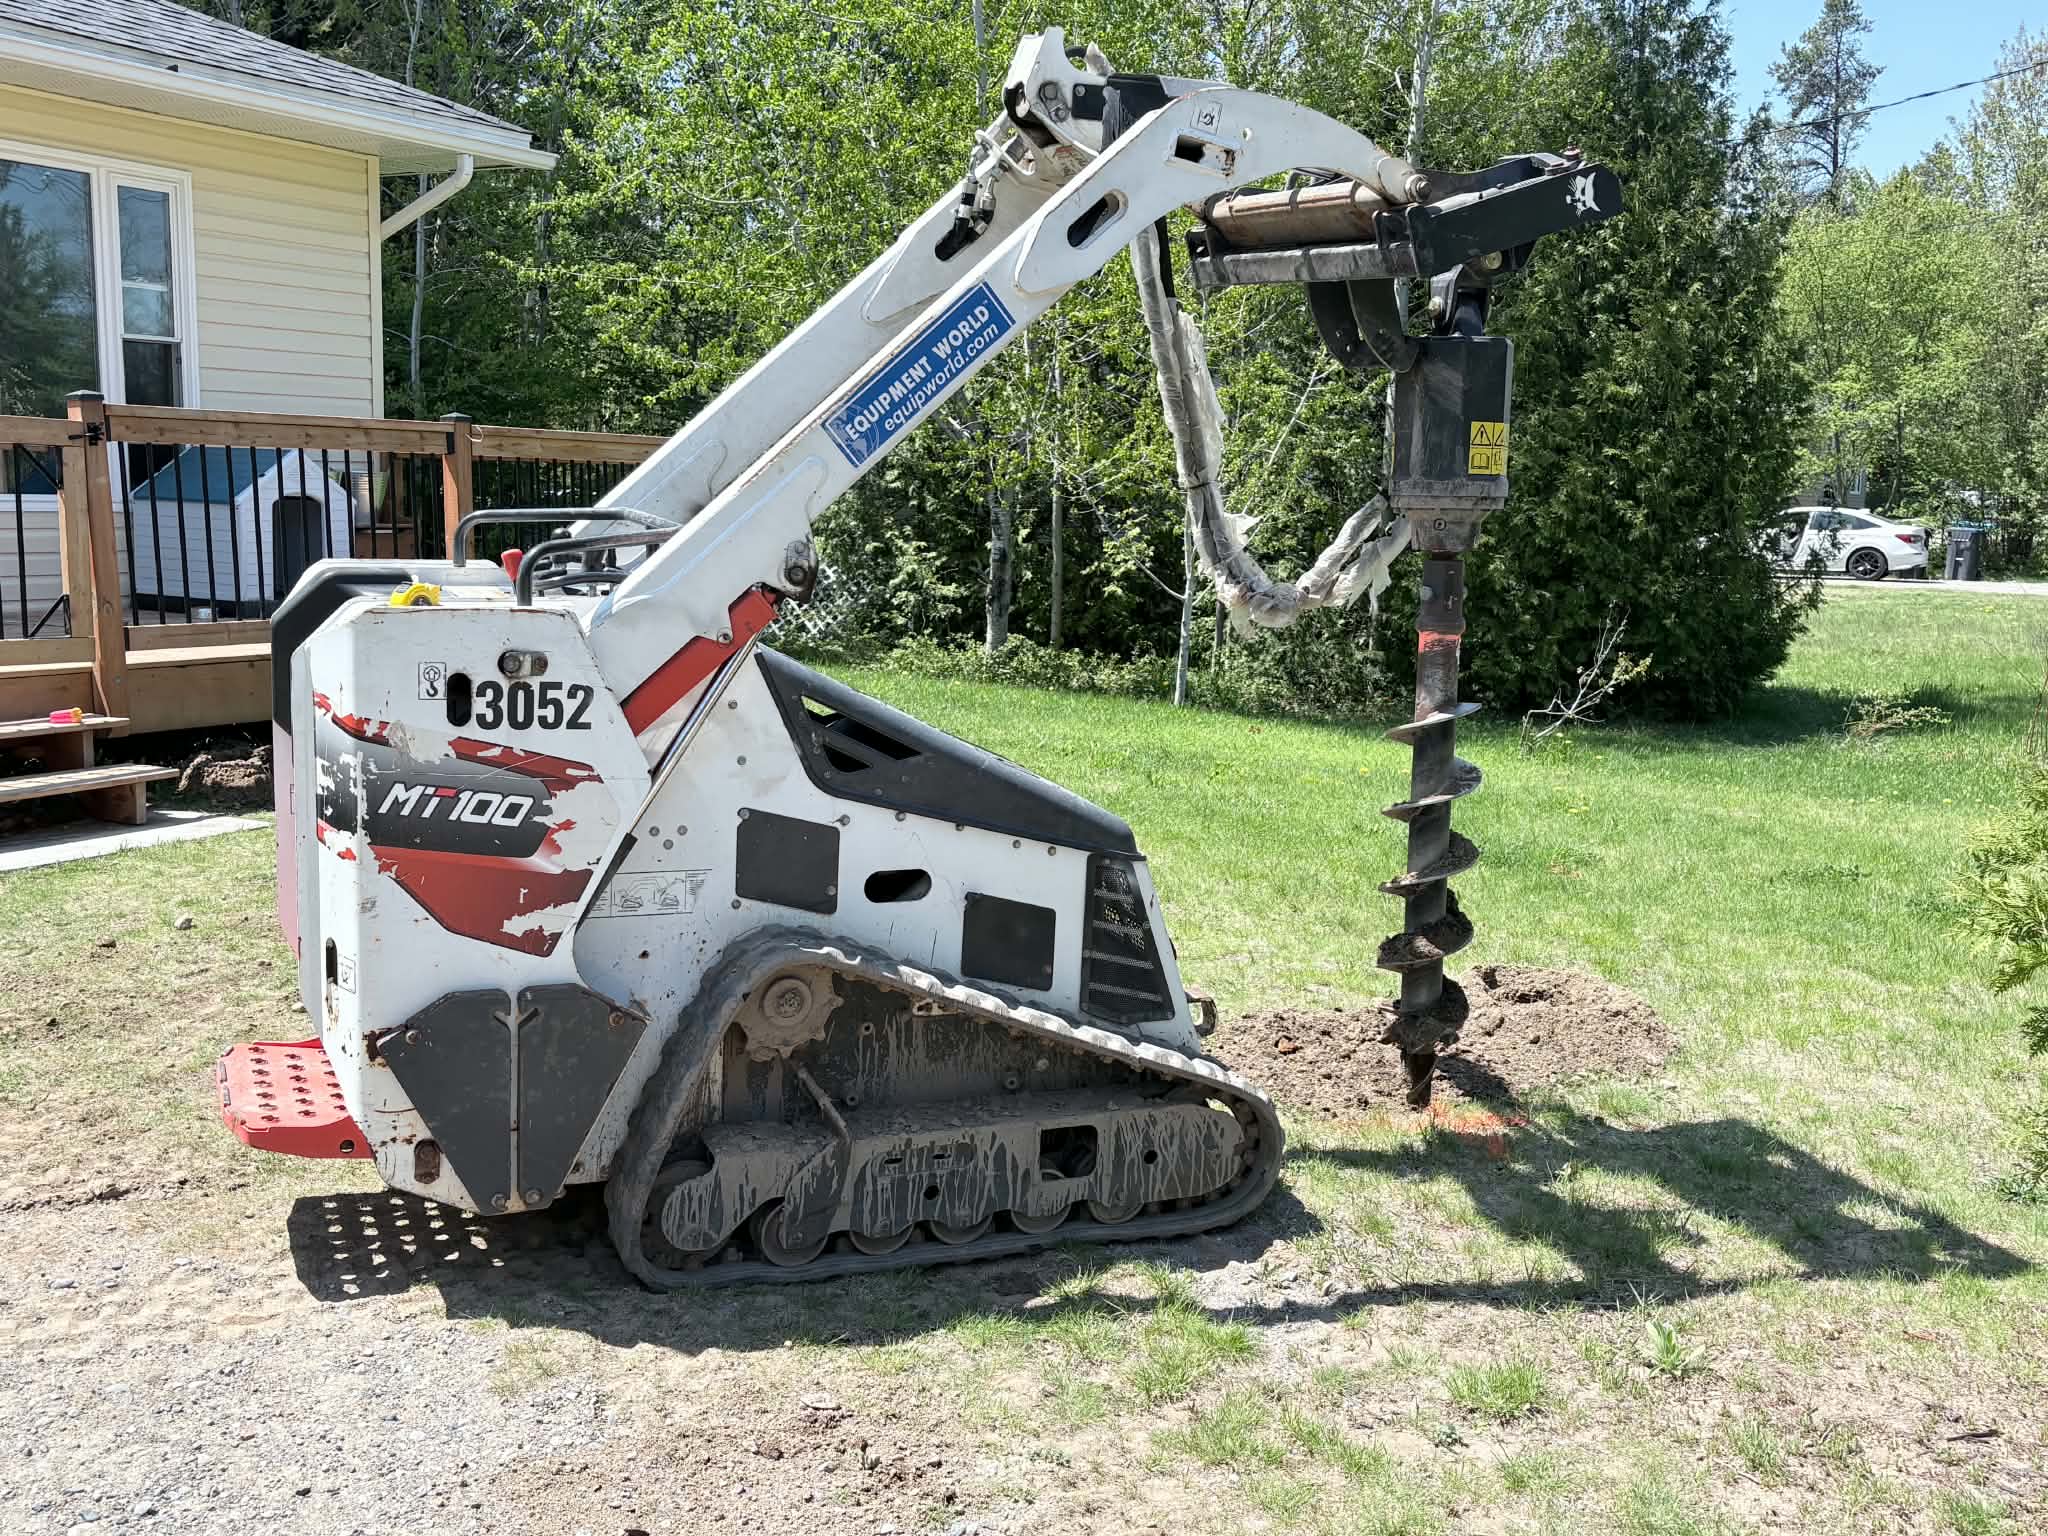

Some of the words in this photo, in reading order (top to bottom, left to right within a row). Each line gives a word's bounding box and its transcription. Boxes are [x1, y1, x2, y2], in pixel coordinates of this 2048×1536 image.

[845, 356, 932, 439] EQUIPMENT
[932, 305, 989, 360] WORLD
[884, 323, 998, 431] equipworld.com
[475, 680, 594, 730] 3052
